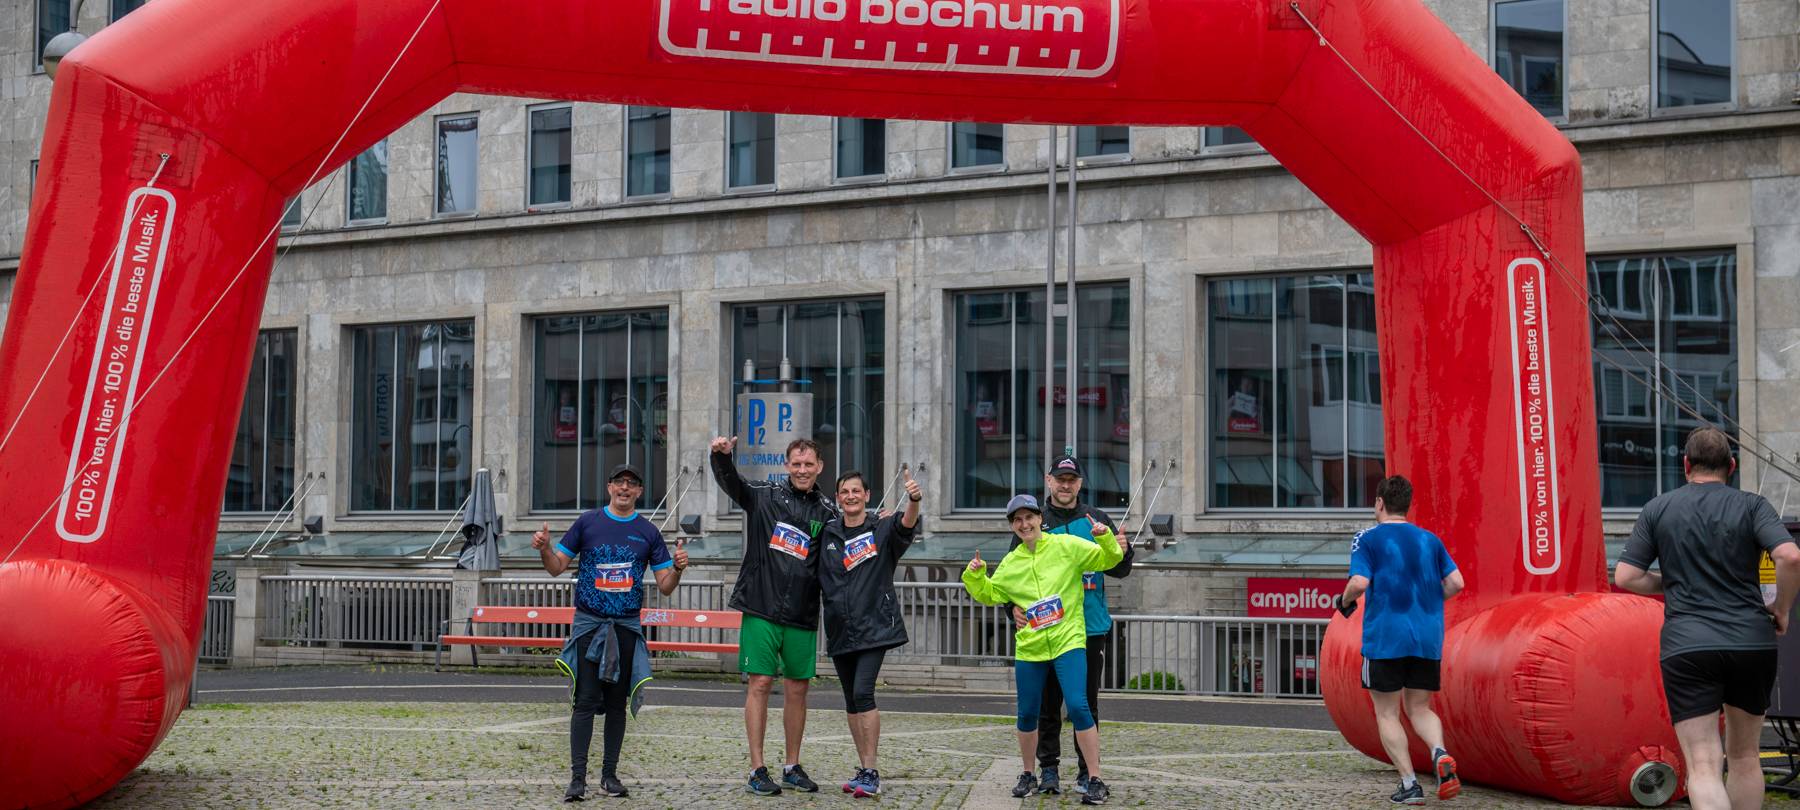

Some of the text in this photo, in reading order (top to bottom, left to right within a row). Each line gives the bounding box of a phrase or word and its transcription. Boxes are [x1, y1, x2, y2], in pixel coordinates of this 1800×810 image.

[859, 0, 1084, 33] bochum
[75, 209, 159, 521] 100% von hier. 100% die beste Musik.
[1521, 276, 1549, 557] 100% von hier. 100% die beste Musik.
